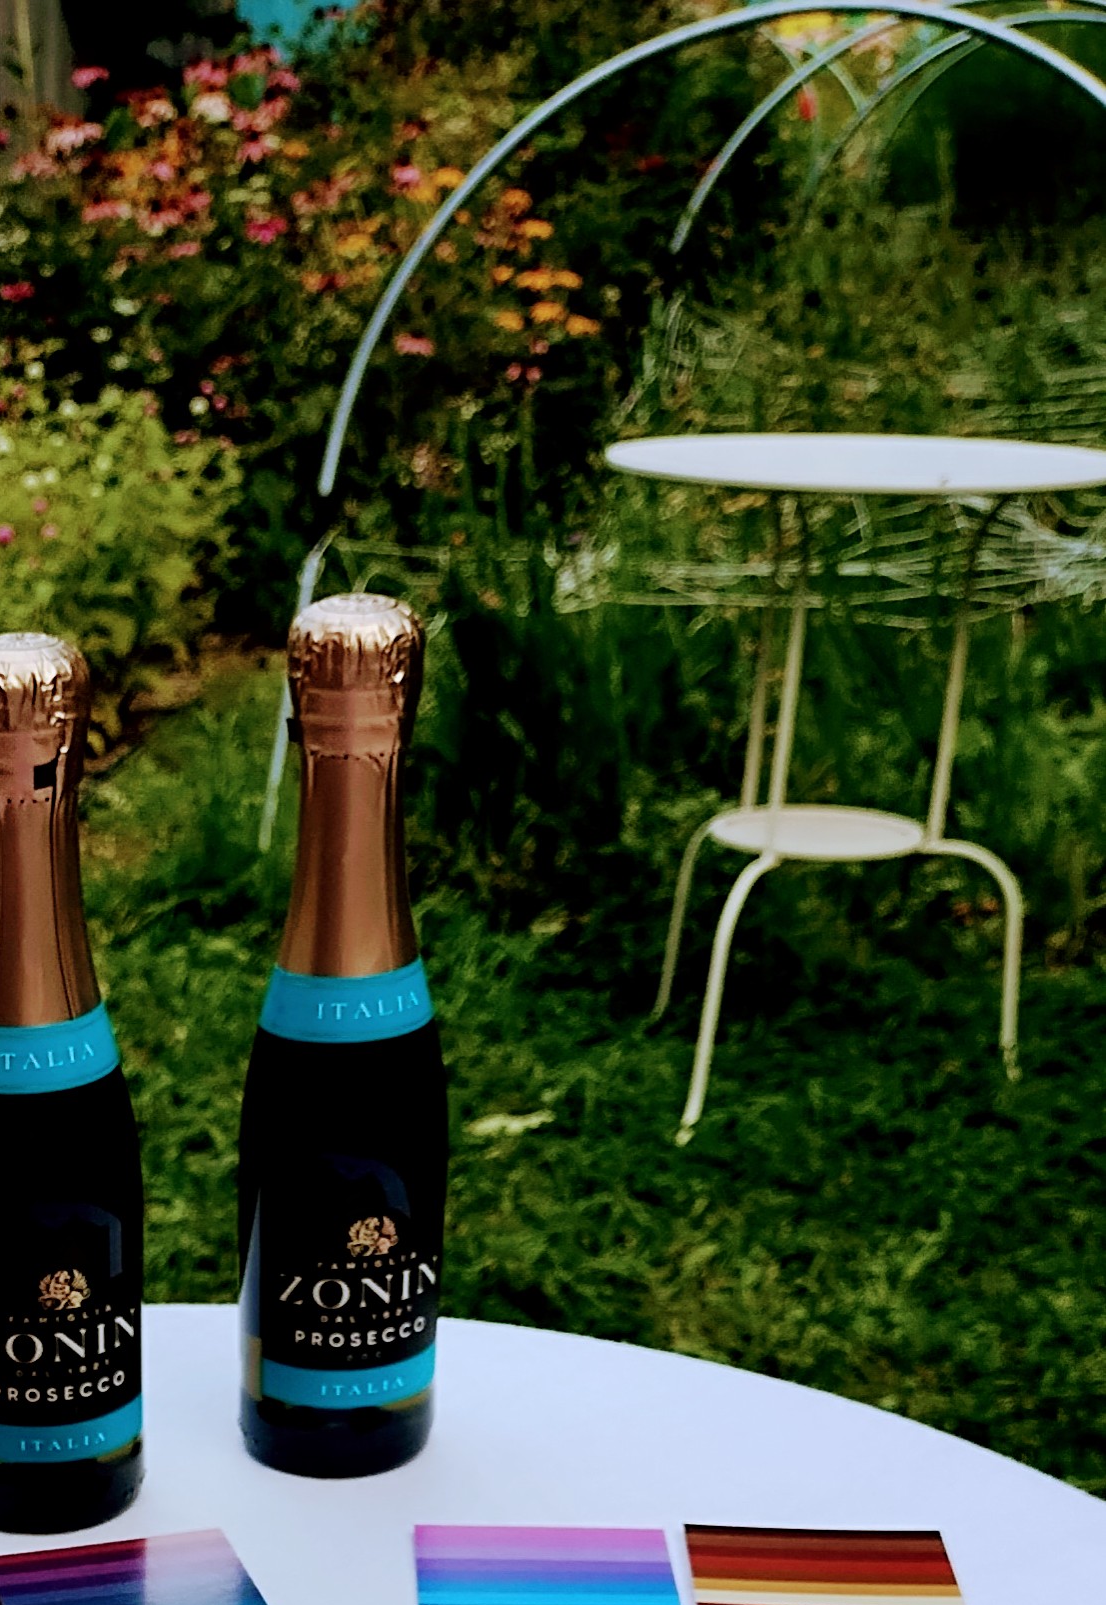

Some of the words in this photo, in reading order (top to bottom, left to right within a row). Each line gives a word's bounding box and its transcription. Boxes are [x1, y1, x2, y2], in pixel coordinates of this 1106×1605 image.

[317, 991, 419, 1020] ITALIA
[279, 1255, 436, 1309] ZONIN
[295, 1316, 426, 1348] PROSECCO
[321, 1376, 405, 1396] ITALIA
[20, 1432, 106, 1452] ITALIA
